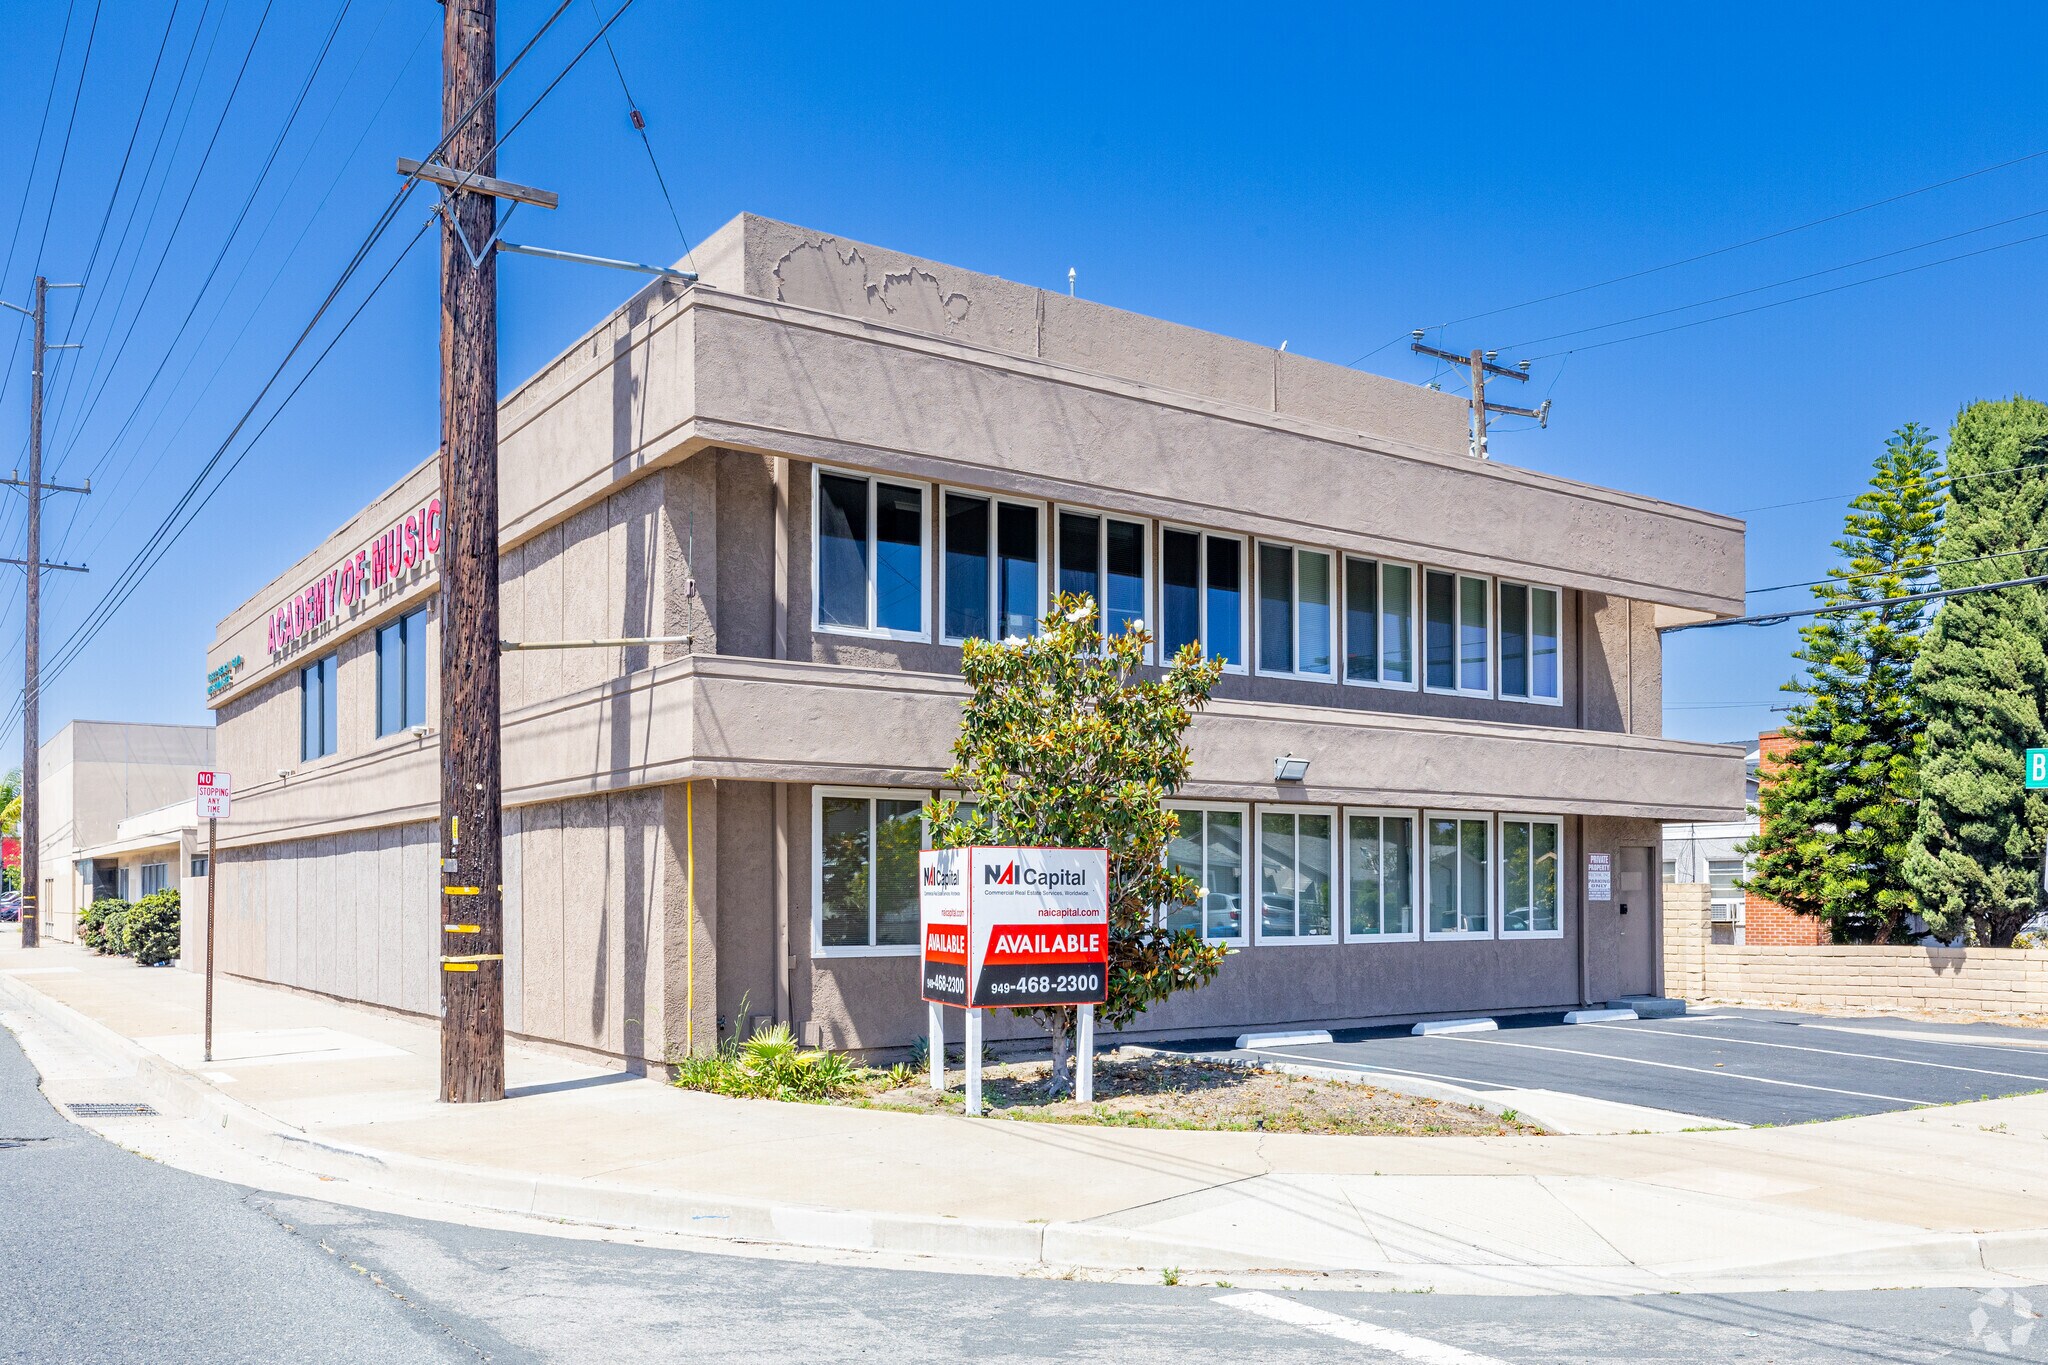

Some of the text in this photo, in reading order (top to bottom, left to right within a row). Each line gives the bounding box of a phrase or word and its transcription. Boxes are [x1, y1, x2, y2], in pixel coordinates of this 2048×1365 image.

[268, 499, 441, 655] ACADEMY OF MUSIC
[2033, 753, 2046, 781] B
[199, 774, 211, 784] NO
[199, 787, 228, 796] STOPPING
[1590, 855, 1608, 863] PRIVATE
[924, 863, 960, 890] NAI Capital
[984, 859, 1086, 889] NAI Capital
[1038, 908, 1100, 919] naicapital.com
[928, 933, 965, 954] AVAILABLE
[995, 934, 1100, 954] AVAILABLE
[927, 974, 964, 995] 949-468-2300
[991, 975, 1099, 995] 949-468-2300
